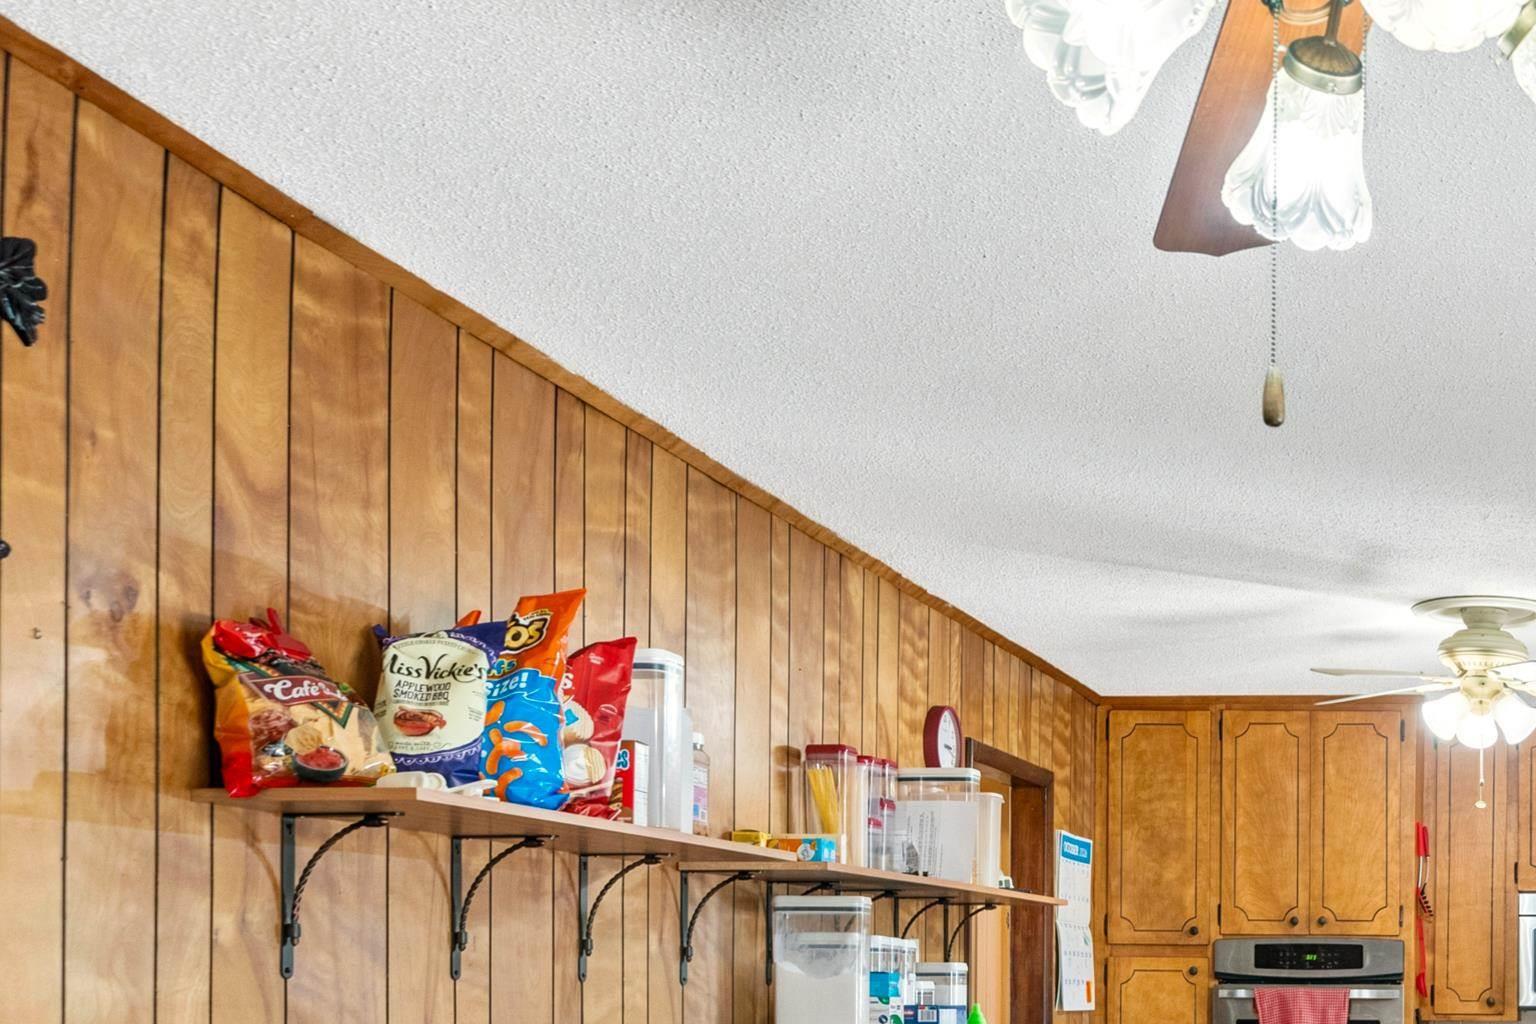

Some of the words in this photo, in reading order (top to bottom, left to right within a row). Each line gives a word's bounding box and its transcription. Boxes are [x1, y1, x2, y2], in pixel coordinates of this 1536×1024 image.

[418, 653, 485, 683] Vickie's
[394, 679, 452, 693] APPLEWOOD
[393, 688, 431, 702] SMOKED
[432, 690, 450, 701] BBQ
